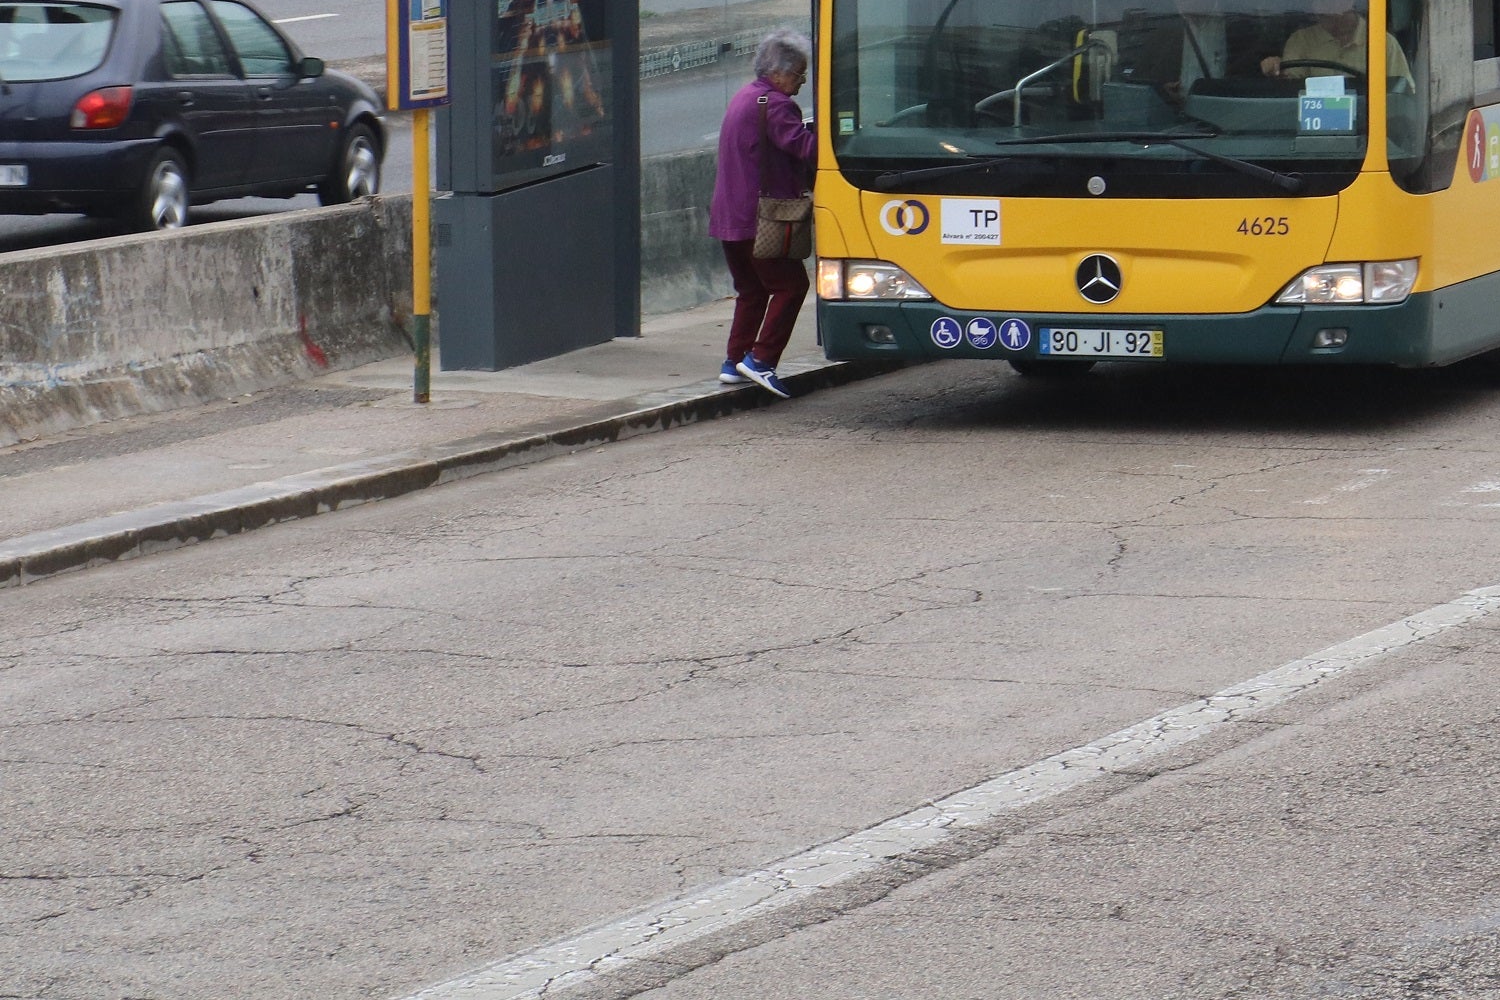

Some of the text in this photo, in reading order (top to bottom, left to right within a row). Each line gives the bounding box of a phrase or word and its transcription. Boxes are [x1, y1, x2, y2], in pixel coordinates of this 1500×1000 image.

[1303, 100, 1322, 110] 736
[1304, 117, 1321, 130] 10
[969, 209, 998, 228] TP
[1236, 216, 1289, 236] 4625
